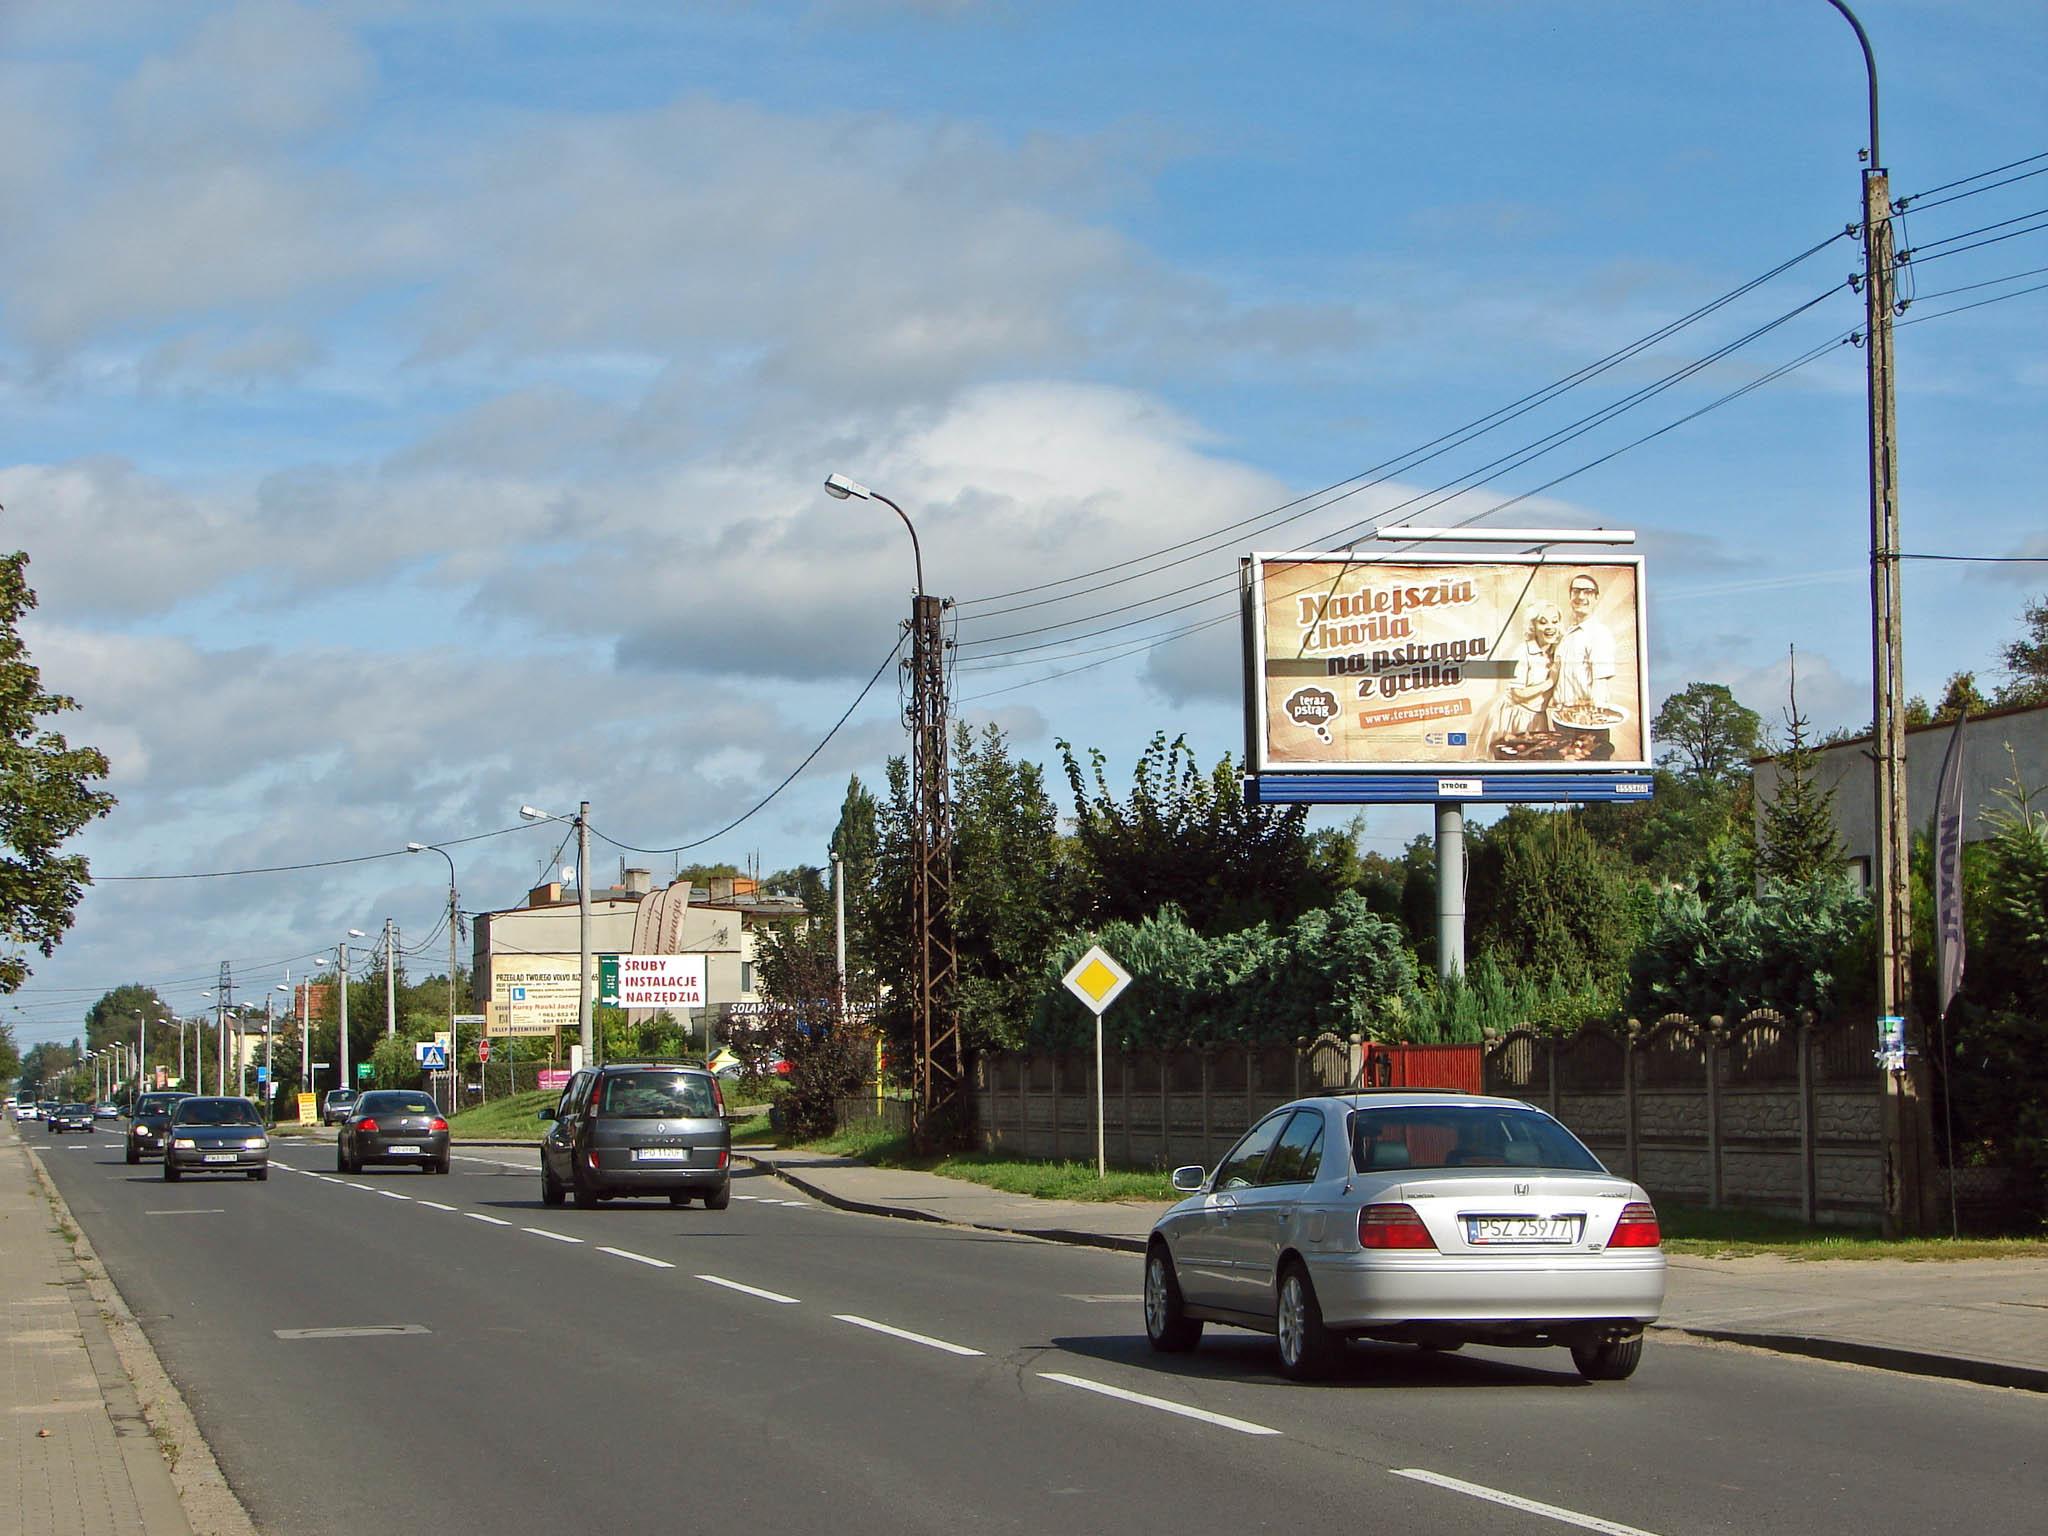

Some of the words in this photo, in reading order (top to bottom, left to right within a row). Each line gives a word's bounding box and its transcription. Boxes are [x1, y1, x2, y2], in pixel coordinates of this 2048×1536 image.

[1328, 654, 1369, 676] na
[1380, 665, 1462, 697] grilla
[1359, 680, 1376, 697] z
[1299, 695, 1326, 706] teraz
[624, 957, 666, 971] ŚRUBY
[526, 973, 552, 981] TWOJEGO
[553, 973, 571, 981] VOLVO
[625, 976, 697, 987] INSTALACJE
[626, 992, 700, 1005] NARZĘDZIA
[1479, 1219, 1513, 1236] PSZ
[1518, 1219, 1568, 1237] 25977
